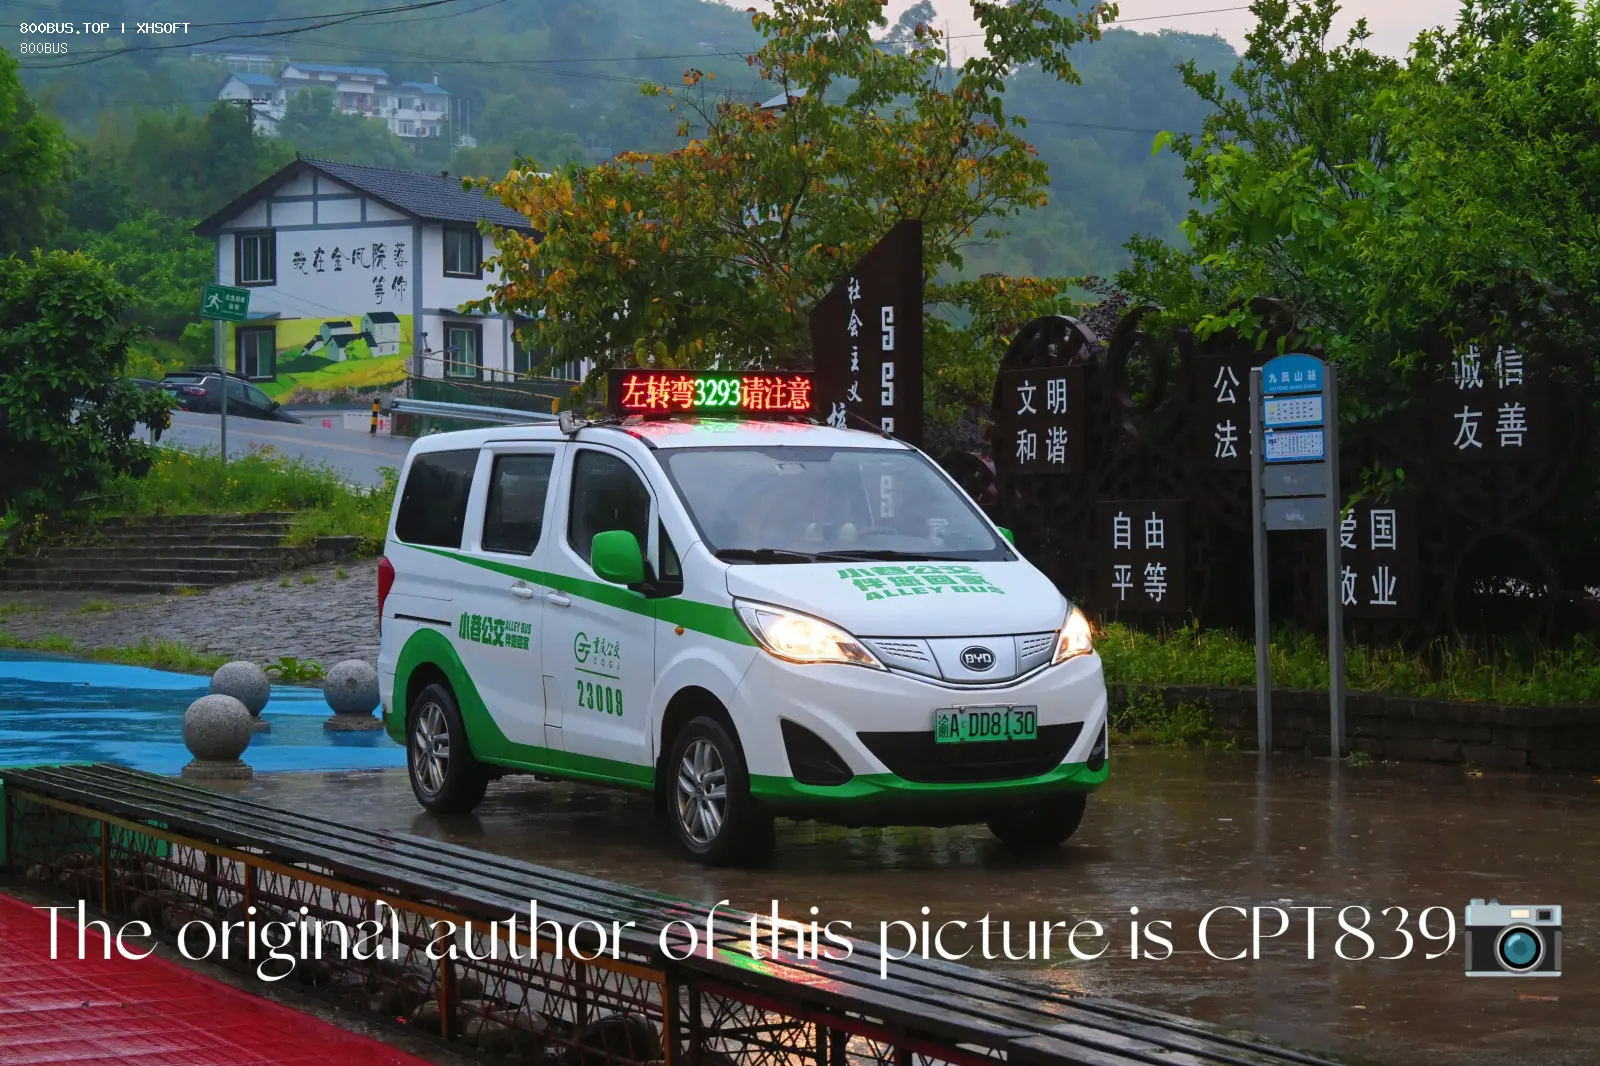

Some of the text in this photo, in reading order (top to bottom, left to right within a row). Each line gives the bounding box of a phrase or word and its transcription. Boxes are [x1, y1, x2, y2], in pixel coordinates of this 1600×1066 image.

[847, 276, 863, 403] 社会主义
[1268, 369, 1317, 384] 九凤山站
[1451, 343, 1523, 390] 诚信
[622, 375, 811, 410] 左转弯3293请注意
[1016, 378, 1068, 416] 文明
[1453, 402, 1528, 450] 友善
[1015, 426, 1068, 465] 和谐
[1113, 511, 1165, 550] 自由
[865, 585, 1006, 601] ALLEY BUS
[1111, 561, 1168, 603] 平等
[458, 611, 506, 648] 小巷公交
[504, 619, 532, 635] ALLEY BUS
[964, 653, 992, 664] BYD
[577, 679, 623, 717] 23009
